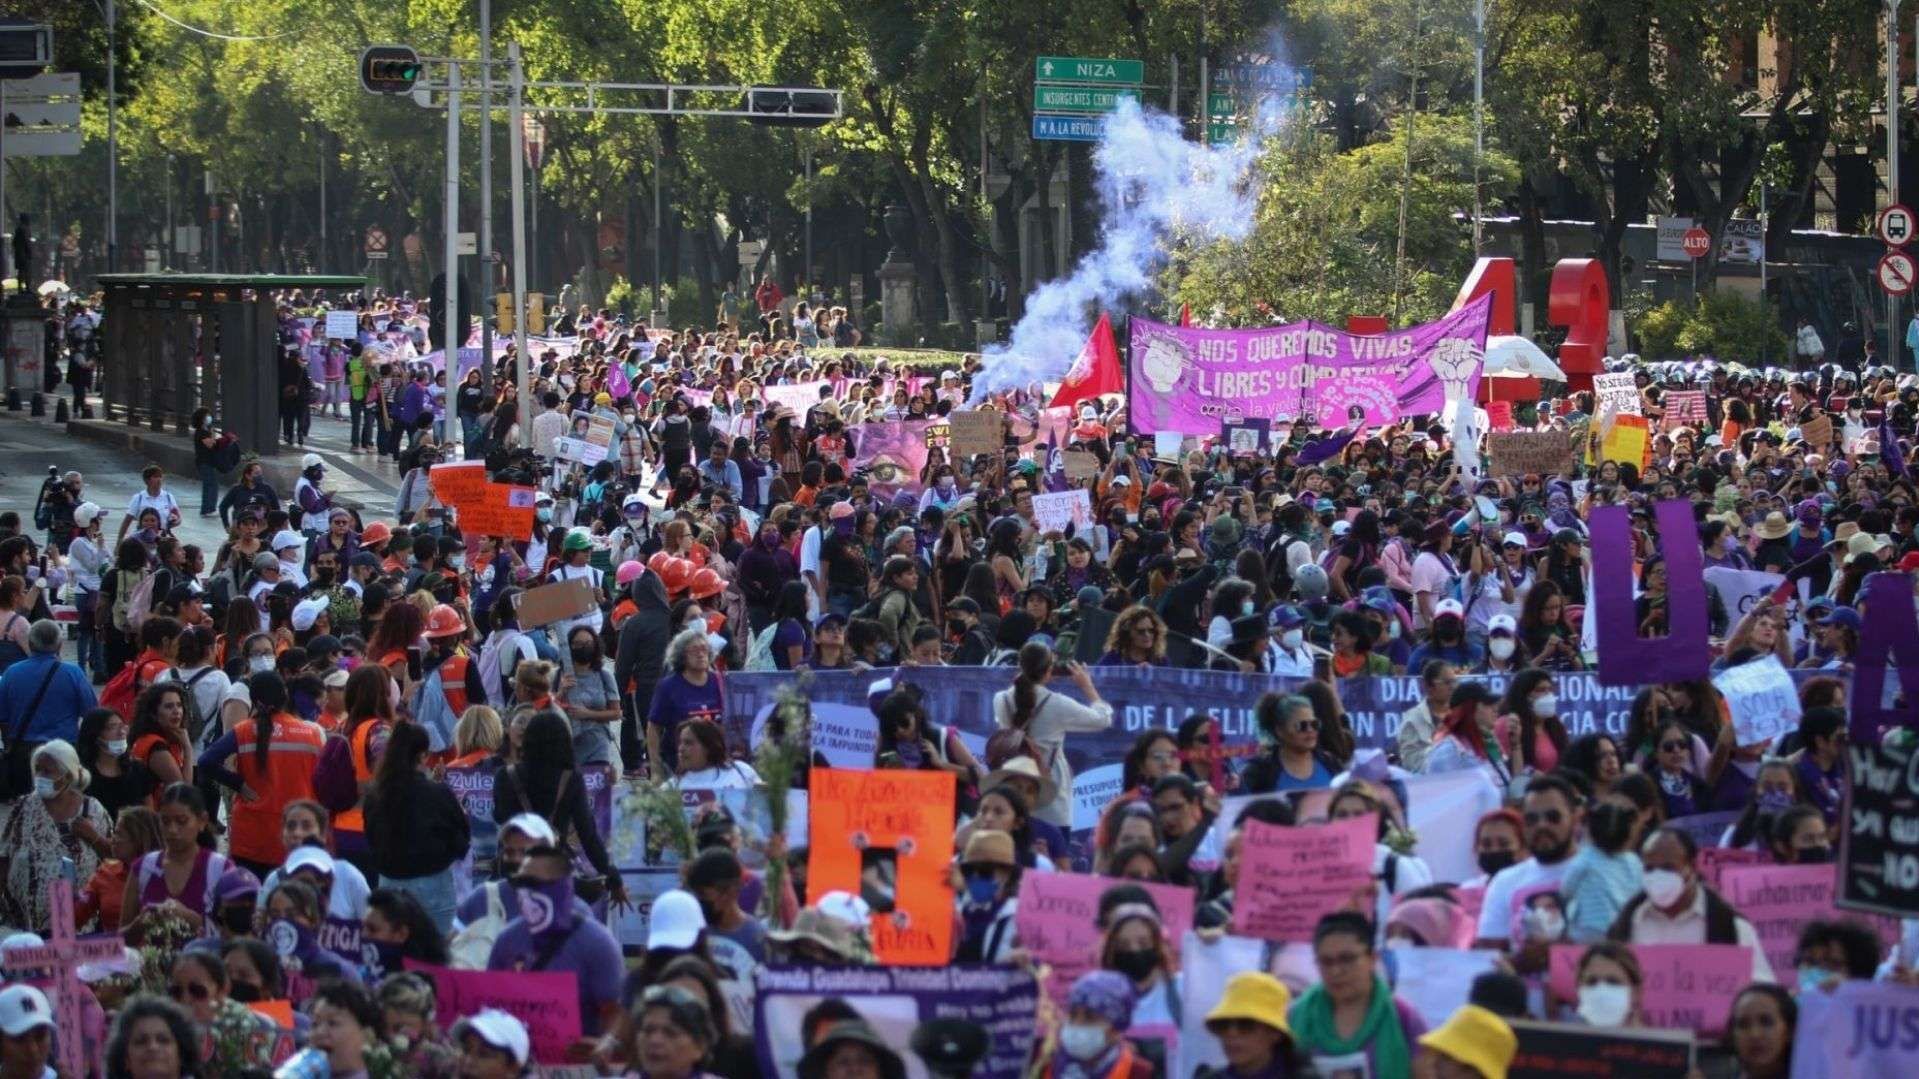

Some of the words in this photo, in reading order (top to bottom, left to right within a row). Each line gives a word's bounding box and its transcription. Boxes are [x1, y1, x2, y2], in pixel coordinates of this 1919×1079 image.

[1077, 63, 1116, 78] NIZA
[1058, 122, 1069, 135] LA
[1683, 237, 1708, 249] ALTO
[1199, 339, 1238, 363] NOS
[1247, 329, 1337, 363] QUEREMOS
[1350, 335, 1413, 360] VIVAS
[1199, 370, 1271, 399] LIBRES
[1381, 678, 1421, 702] DIA
